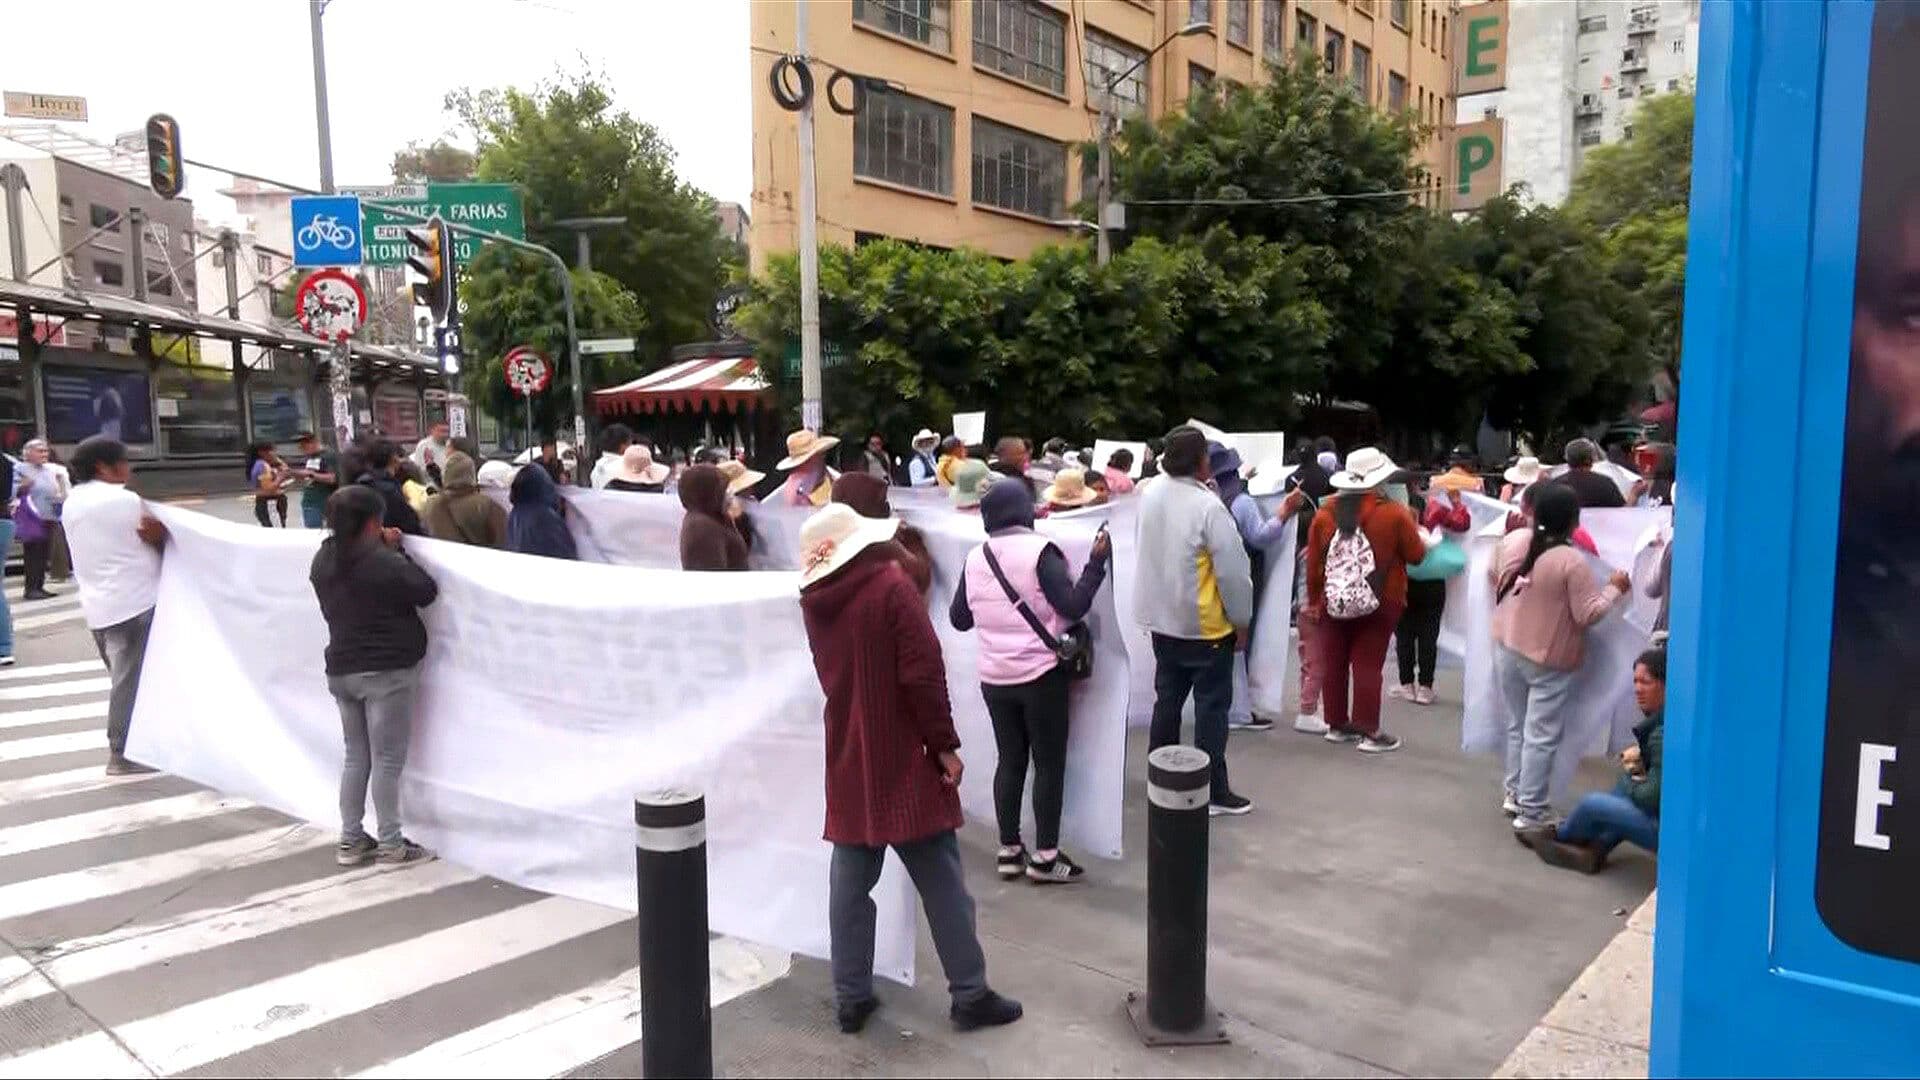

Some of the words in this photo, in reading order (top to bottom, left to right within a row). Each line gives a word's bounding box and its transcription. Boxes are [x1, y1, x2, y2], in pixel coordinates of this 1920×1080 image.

[1466, 16, 1499, 76] E
[1458, 136, 1494, 194] P
[450, 203, 507, 219] FARIAS
[363, 243, 419, 260] NTONIO
[1854, 743, 1897, 850] E
